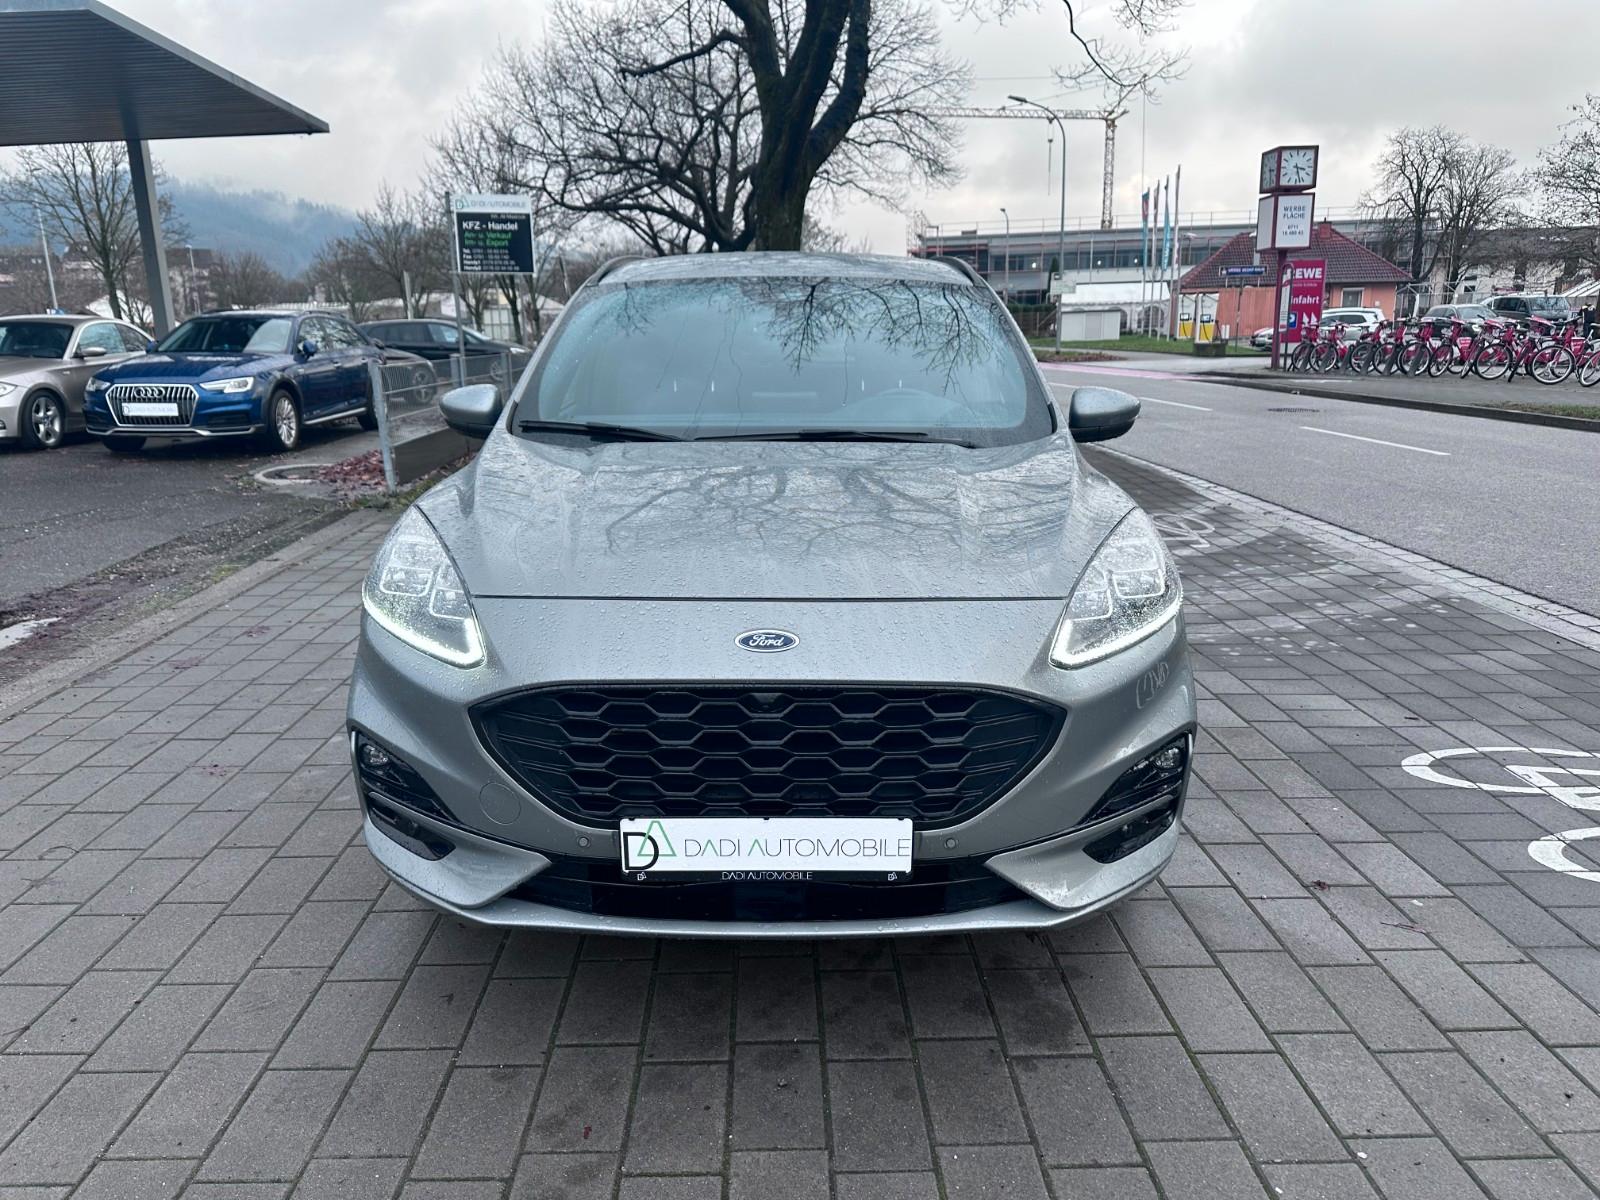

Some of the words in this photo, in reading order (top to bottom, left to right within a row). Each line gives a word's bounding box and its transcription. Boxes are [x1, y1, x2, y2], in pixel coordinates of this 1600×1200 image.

[462, 221, 481, 230] KFZ
[487, 221, 519, 231] Handel
[486, 239, 508, 247] Export
[1290, 295, 1320, 305] infahrt
[749, 633, 785, 646] Ford
[684, 838, 741, 857] DADI
[747, 838, 911, 857] AUTOMOBILE
[721, 871, 746, 881] DADI
[747, 871, 813, 881] AUTOMOBILE
